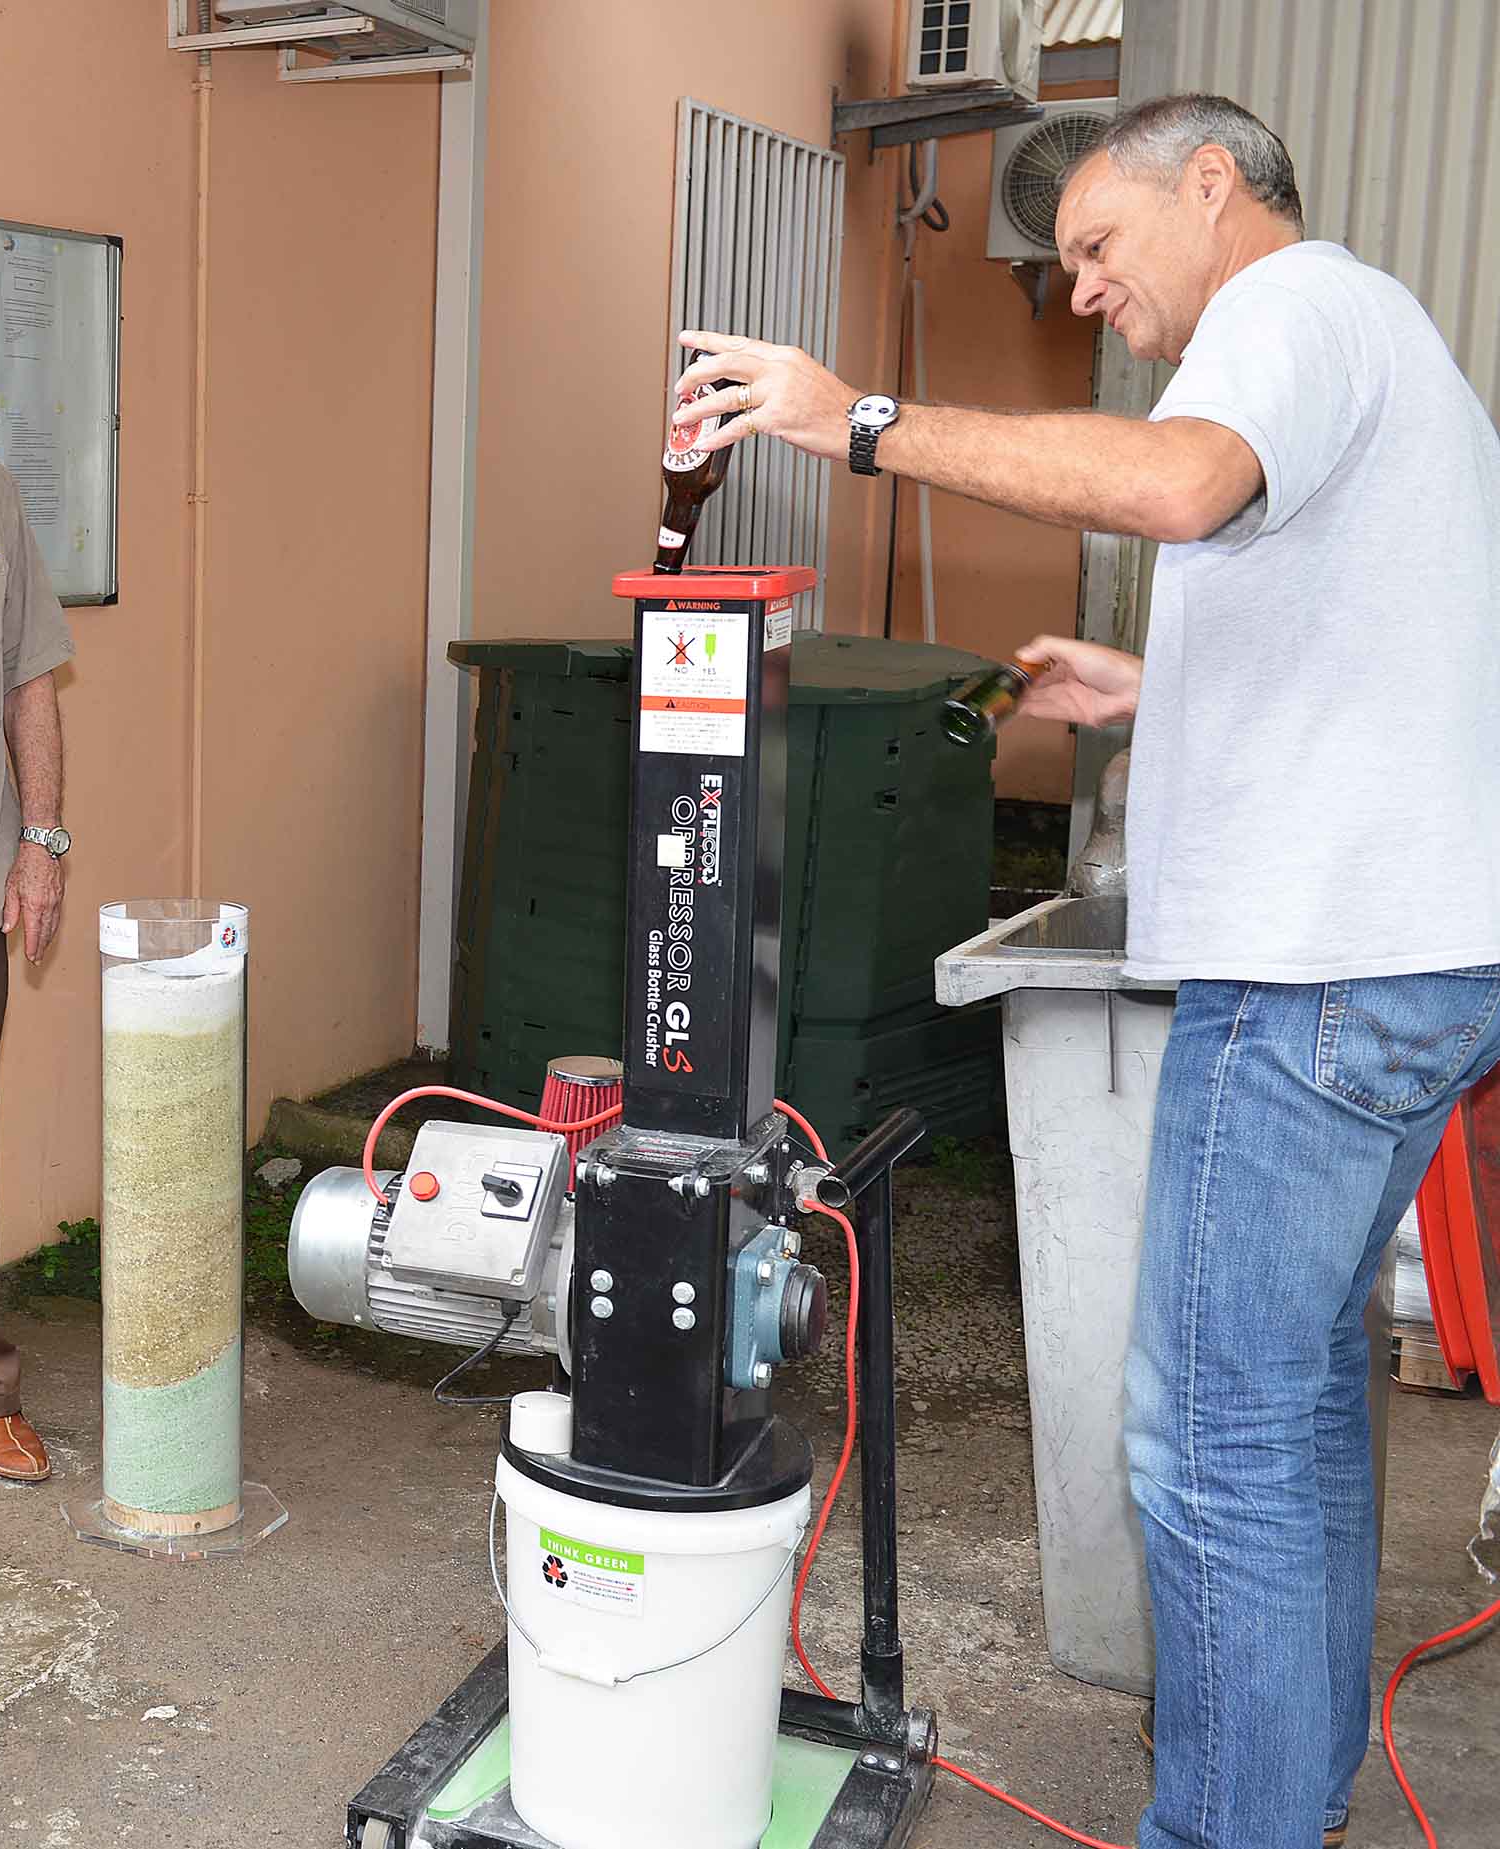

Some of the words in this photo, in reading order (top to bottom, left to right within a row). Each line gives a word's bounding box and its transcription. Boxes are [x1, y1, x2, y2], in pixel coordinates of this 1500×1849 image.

[678, 602, 720, 610] WARNING
[674, 666, 688, 674] NO
[703, 667, 717, 675] YES
[649, 930, 663, 967] Glass
[647, 969, 663, 1011] Bottle
[646, 1013, 661, 1067] Crusher
[663, 1002, 693, 1072] GLS
[547, 1539, 580, 1559] THINK
[585, 1553, 628, 1570] GREEN
